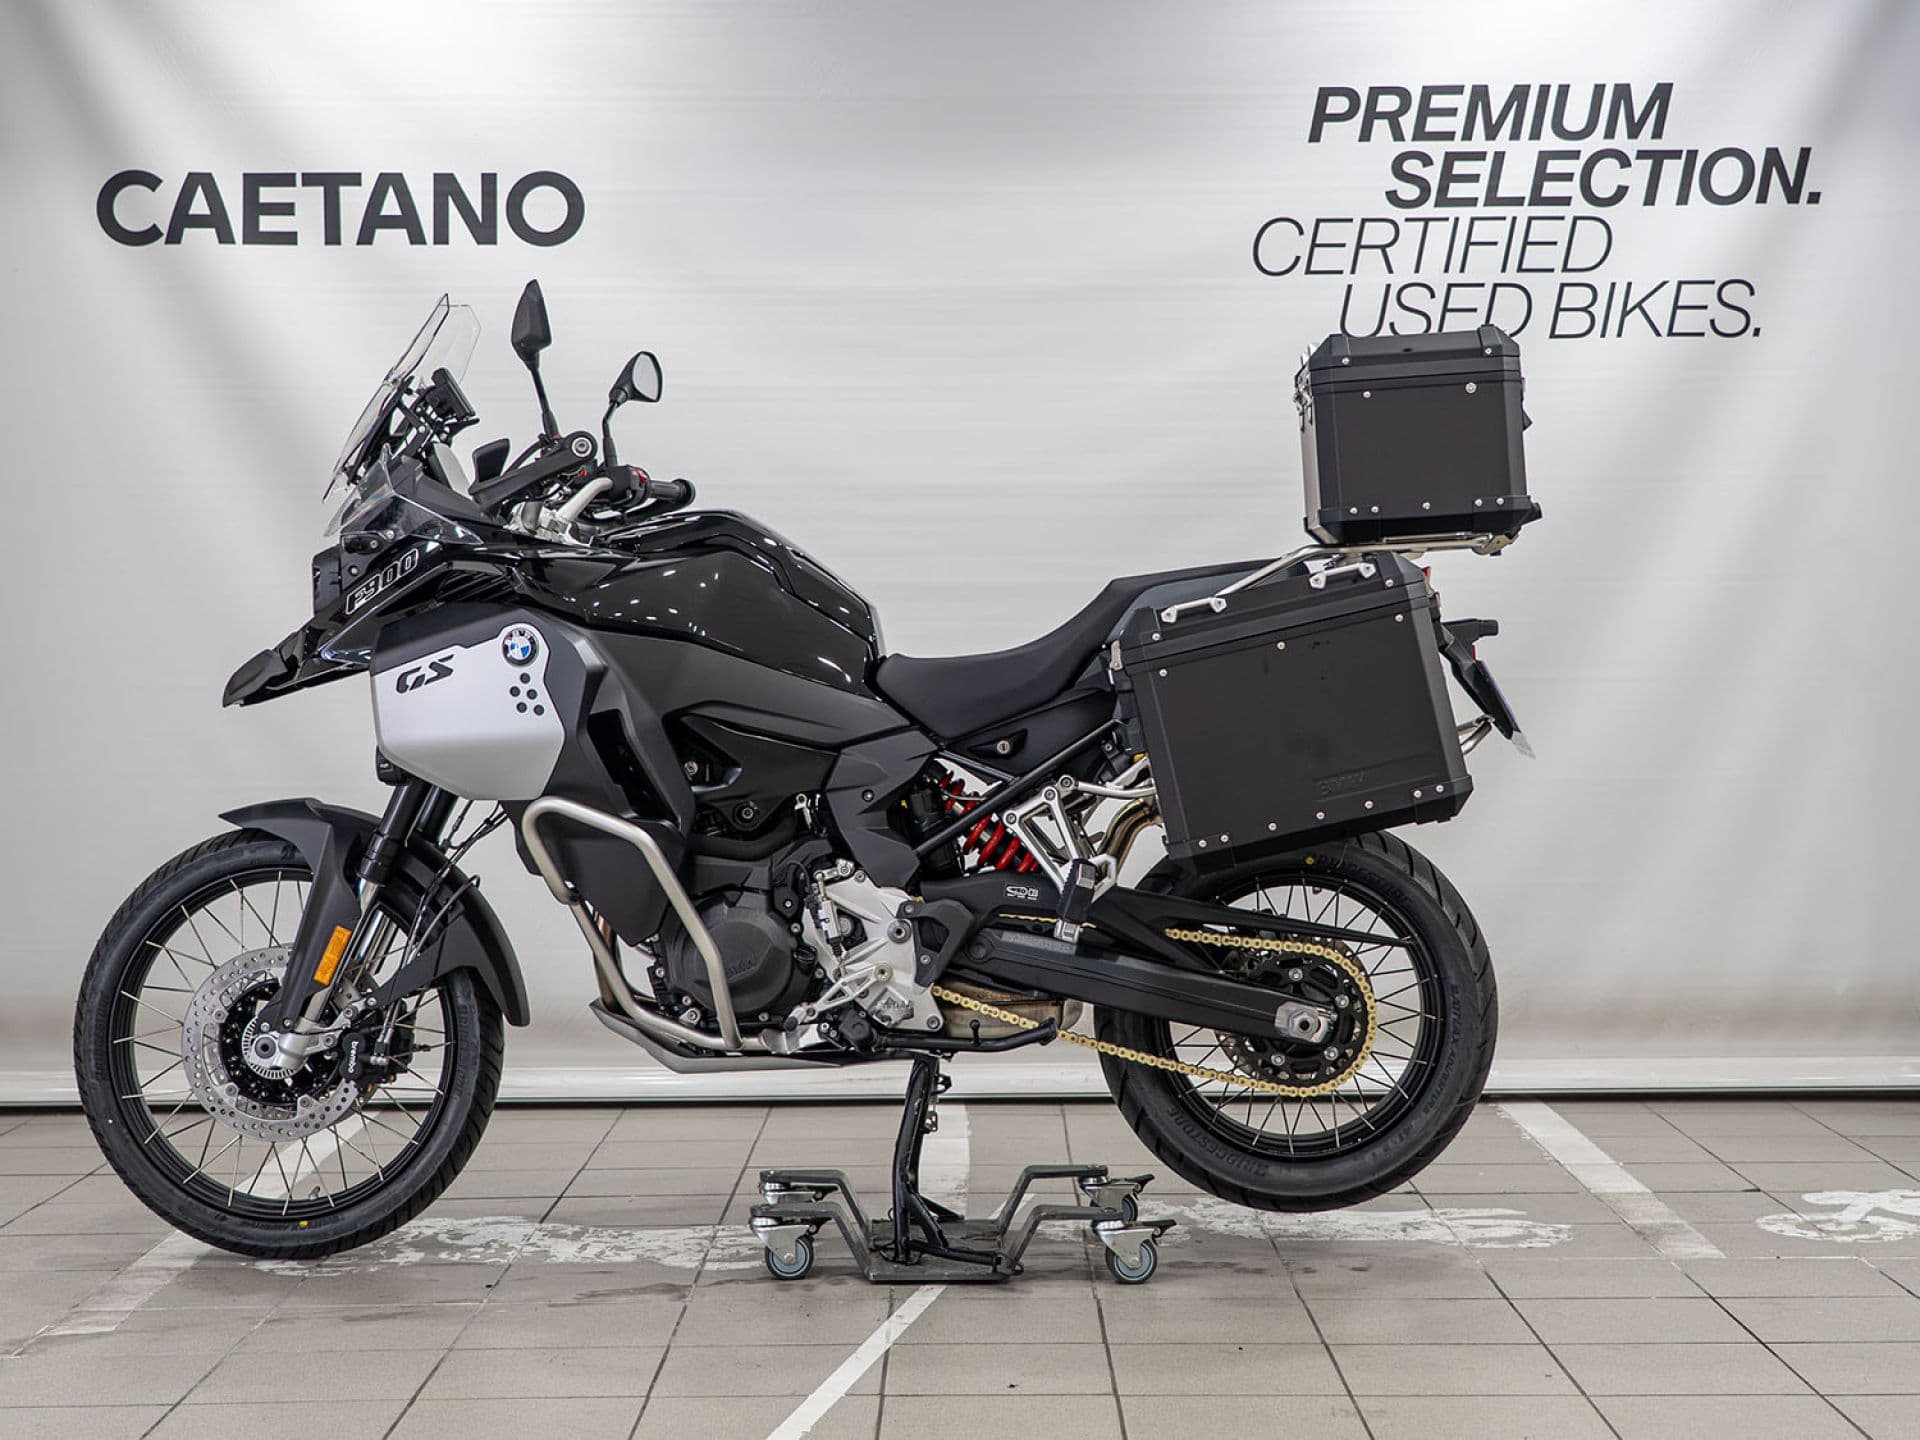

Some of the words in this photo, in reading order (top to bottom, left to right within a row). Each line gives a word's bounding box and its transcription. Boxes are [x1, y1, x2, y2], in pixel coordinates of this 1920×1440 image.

[1308, 82, 1674, 143] PREMIUM
[1385, 147, 1822, 208] SELECTION.
[96, 170, 585, 247] CAETANO
[1252, 215, 1613, 277] CERTIFIED
[1339, 283, 1533, 338] USED
[1549, 278, 1763, 339] BIKES.
[346, 549, 419, 615] F900
[396, 655, 454, 693] GS
[347, 1041, 359, 1073] brembo
